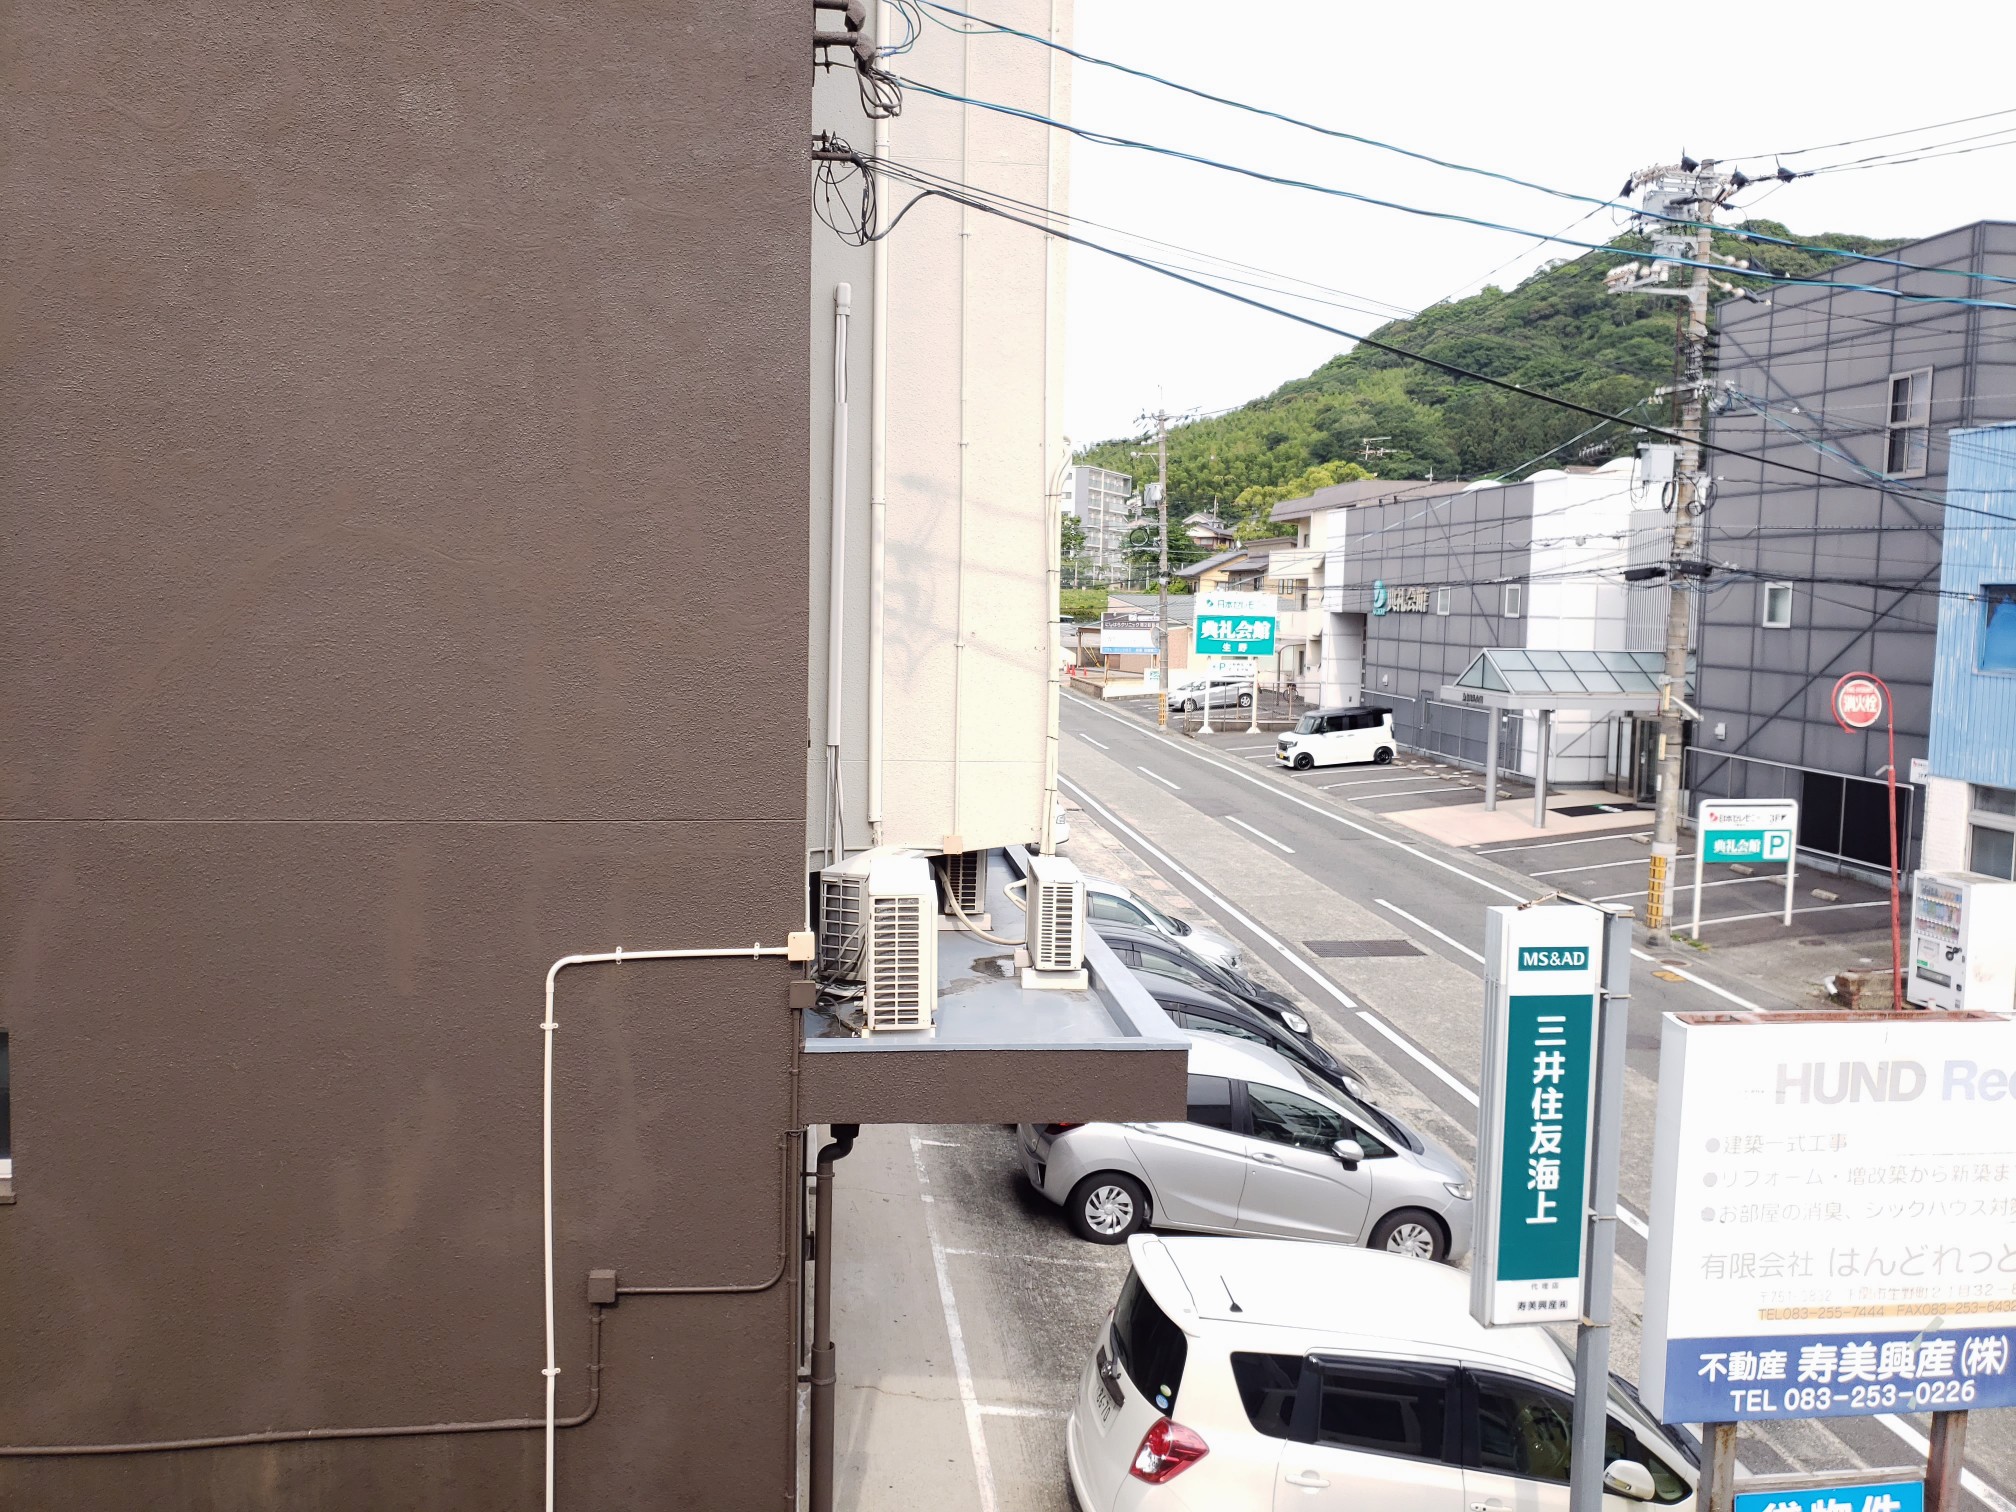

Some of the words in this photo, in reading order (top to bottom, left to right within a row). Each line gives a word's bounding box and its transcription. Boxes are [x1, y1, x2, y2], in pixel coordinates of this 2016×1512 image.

[1843, 694, 1878, 713] 消火栓
[1768, 835, 1785, 855] P
[1523, 951, 1586, 967] MS&AD
[1775, 1060, 1927, 1105] HUND
[1525, 1015, 1567, 1225] 三井住友海上
[1724, 1133, 1848, 1155] 建築一式工事
[1721, 1164, 2016, 1189] リフォーム・増改築から新築ま
[1700, 1250, 1814, 1280] 有限会社
[1698, 1350, 1788, 1383] 不動産
[1798, 1335, 2009, 1384] 寿美興産(株)
[1730, 1388, 1777, 1413] TEL
[1784, 1378, 1976, 1411] 083-253-0226
